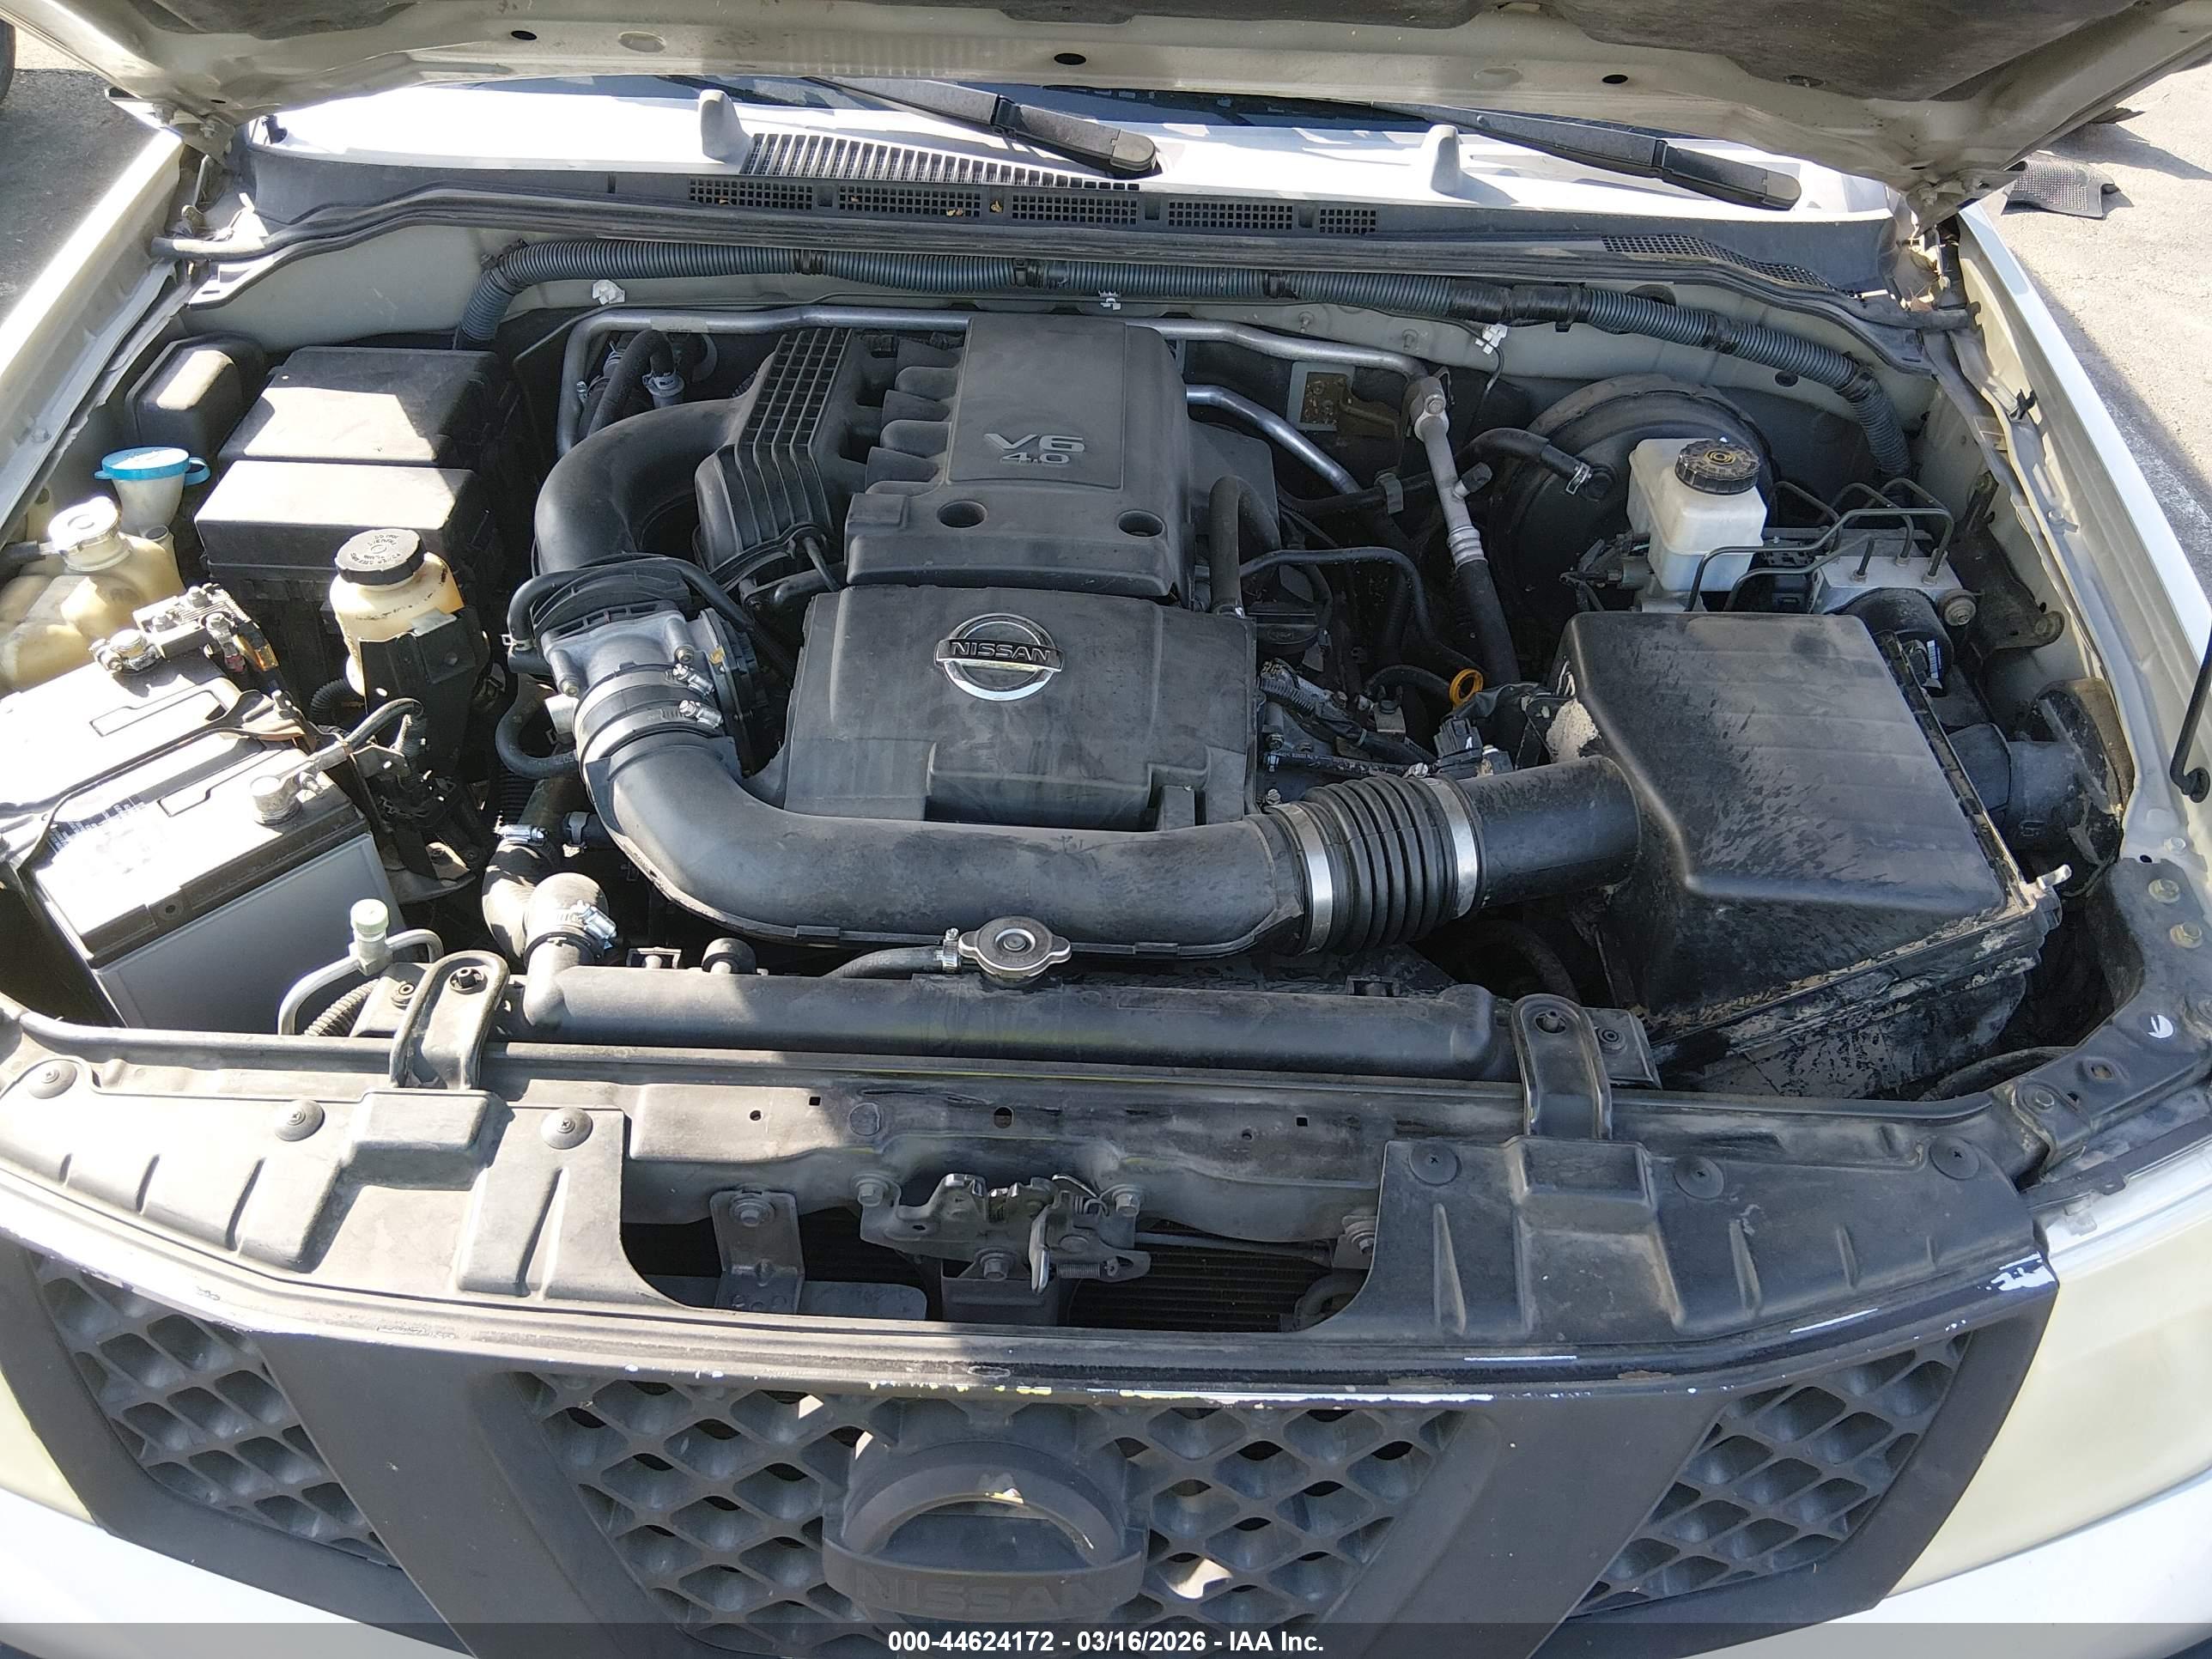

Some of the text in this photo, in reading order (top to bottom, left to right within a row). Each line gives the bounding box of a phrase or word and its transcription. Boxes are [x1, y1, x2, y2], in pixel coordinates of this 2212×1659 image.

[983, 433, 1085, 452] V6
[1000, 452, 1069, 465] 4.0
[951, 641, 1052, 662] NISSAN
